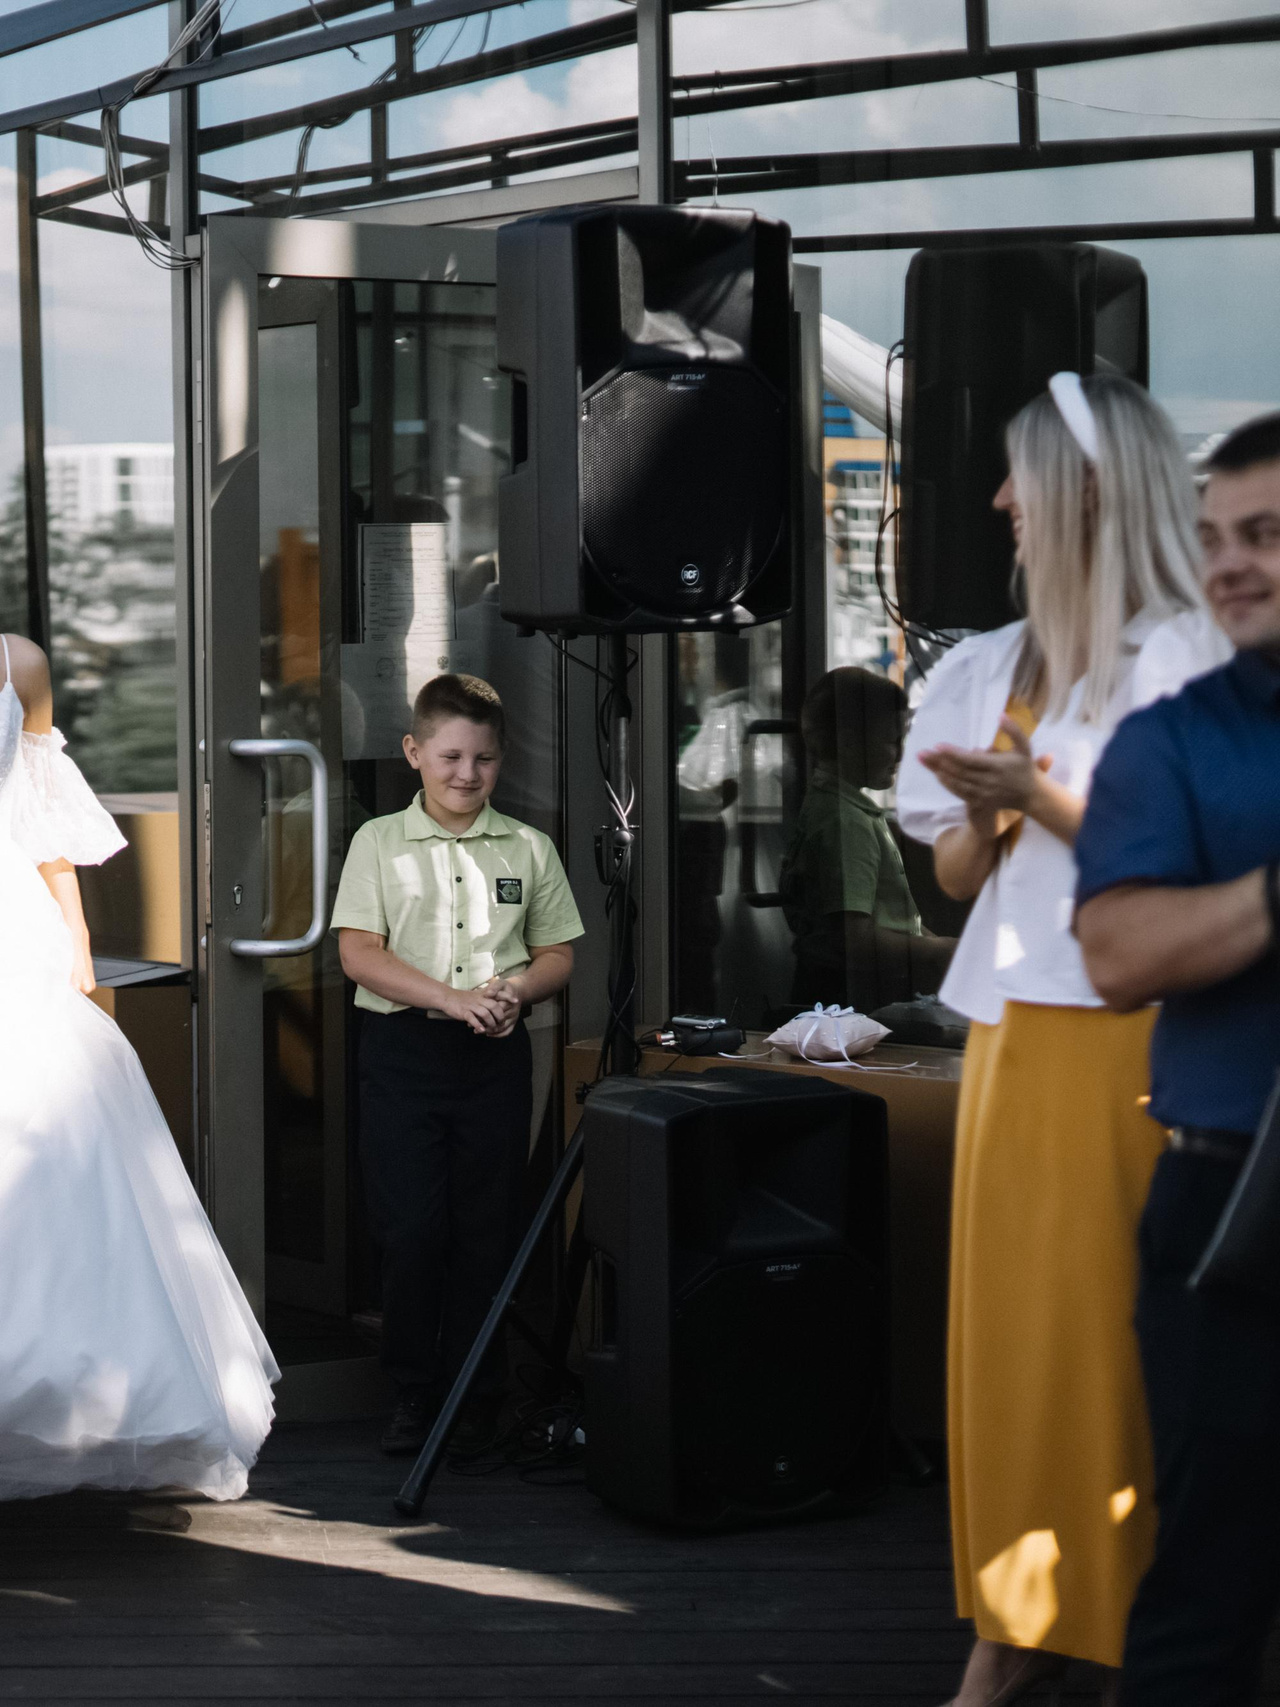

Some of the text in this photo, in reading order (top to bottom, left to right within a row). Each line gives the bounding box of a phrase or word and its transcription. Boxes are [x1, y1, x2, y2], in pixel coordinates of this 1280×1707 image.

[670, 373, 684, 381] ART
[683, 569, 698, 580] RCF
[765, 1264, 780, 1273] ART
